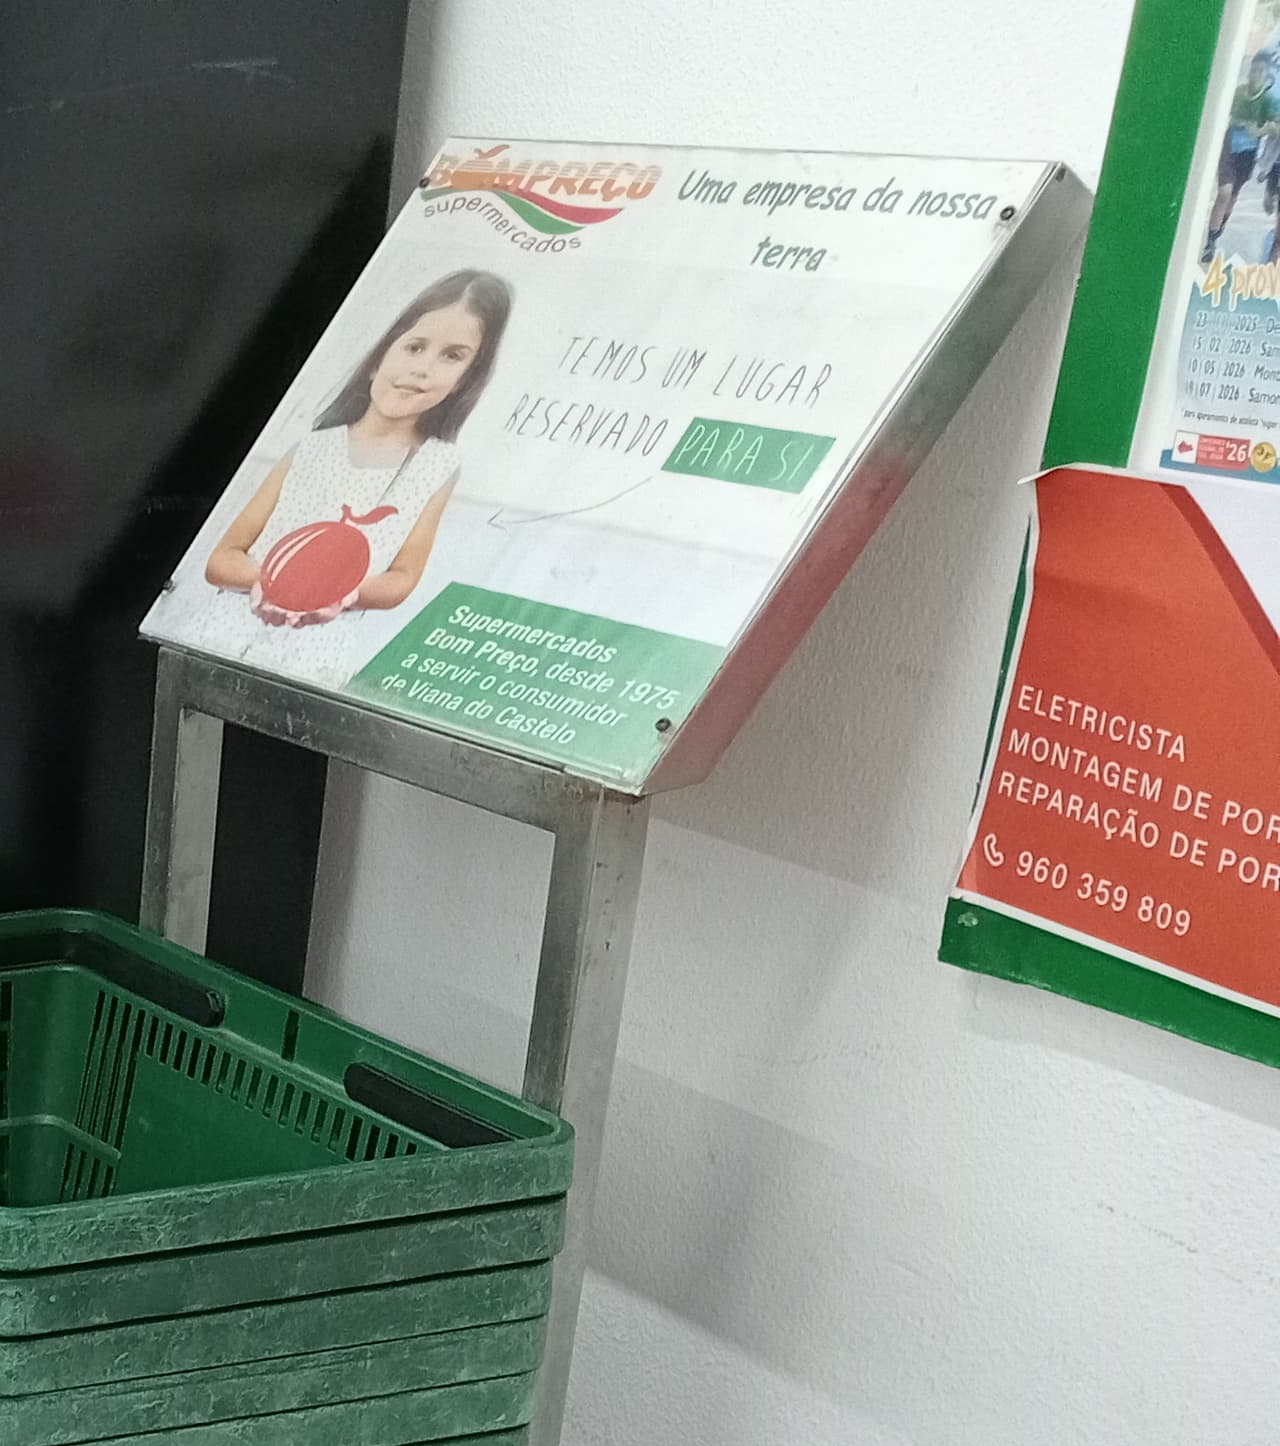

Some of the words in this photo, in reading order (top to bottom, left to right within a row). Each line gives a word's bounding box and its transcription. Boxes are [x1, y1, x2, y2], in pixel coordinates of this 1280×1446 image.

[423, 195, 582, 254] supermercados
[678, 169, 737, 205] Uma
[742, 178, 857, 216] empresa
[862, 176, 903, 213] da
[906, 188, 998, 220] nossa
[749, 236, 828, 272] terra
[1201, 254, 1227, 308] 4
[557, 335, 657, 384] TEMOS
[661, 346, 708, 391] UM
[712, 353, 833, 409] LUGAR
[503, 393, 669, 457] RESERVADO
[673, 423, 765, 475] PARA
[773, 440, 815, 482] SI
[423, 627, 477, 655] Bom
[478, 639, 540, 677] Preço,
[544, 661, 615, 694] desde
[617, 678, 681, 711] 1975
[447, 604, 618, 664] Supermercados
[381, 673, 407, 696] de
[407, 678, 467, 711] Viana
[463, 697, 494, 721] do
[495, 705, 577, 745] Castelo
[400, 652, 419, 669] a
[417, 655, 481, 686] servir
[478, 674, 497, 691] o
[496, 680, 628, 728] consumidor
[1016, 684, 1187, 763] ELETRICISTA
[1007, 728, 1164, 804] MONTAGEM
[1172, 783, 1213, 821] DE
[997, 770, 1160, 851] REPARAÇÃO
[1169, 830, 1208, 867] DE
[1015, 850, 1068, 890] 960
[1076, 871, 1129, 913] 359
[1137, 894, 1192, 938] 809
